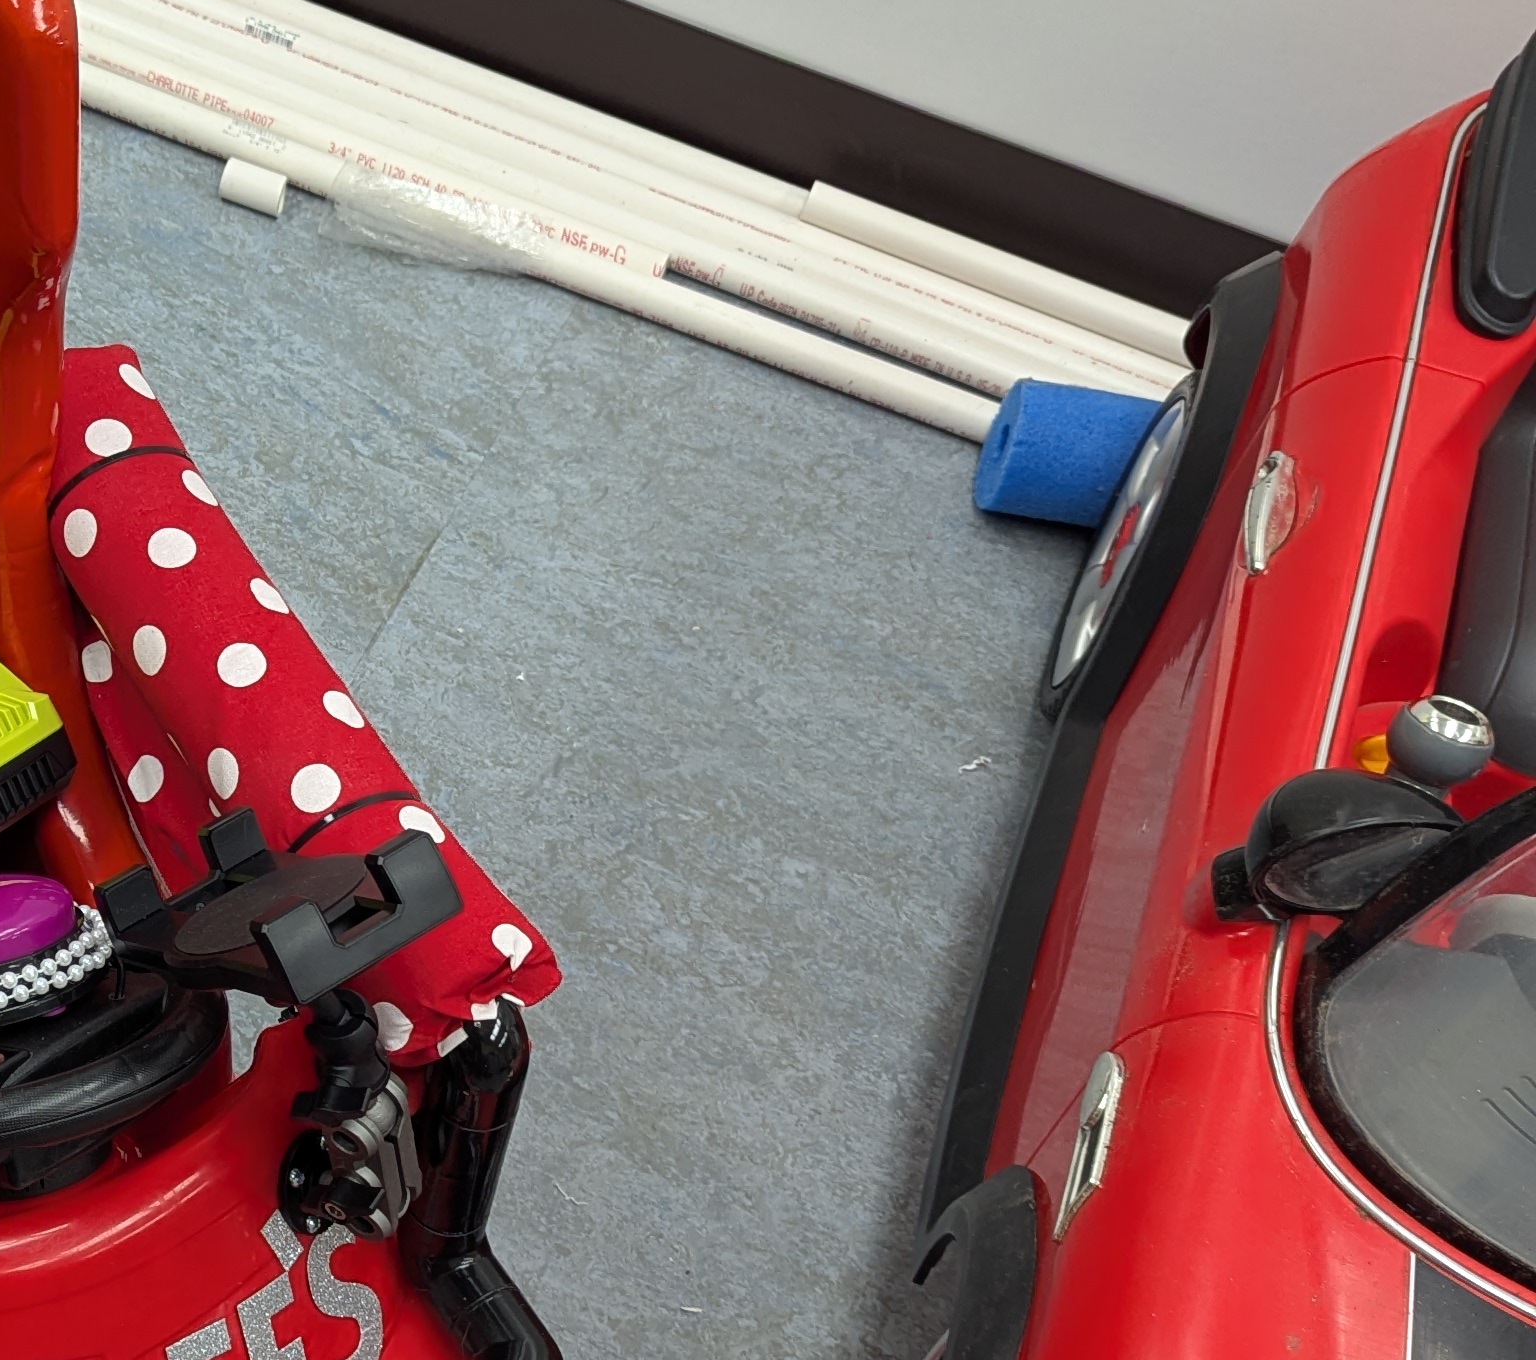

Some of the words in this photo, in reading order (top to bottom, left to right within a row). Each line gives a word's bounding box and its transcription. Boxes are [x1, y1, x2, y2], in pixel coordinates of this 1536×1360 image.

[146, 69, 200, 101] CHARLOTTE
[203, 93, 228, 113] PIPE
[356, 152, 377, 171] PVC
[382, 162, 406, 182] 1120
